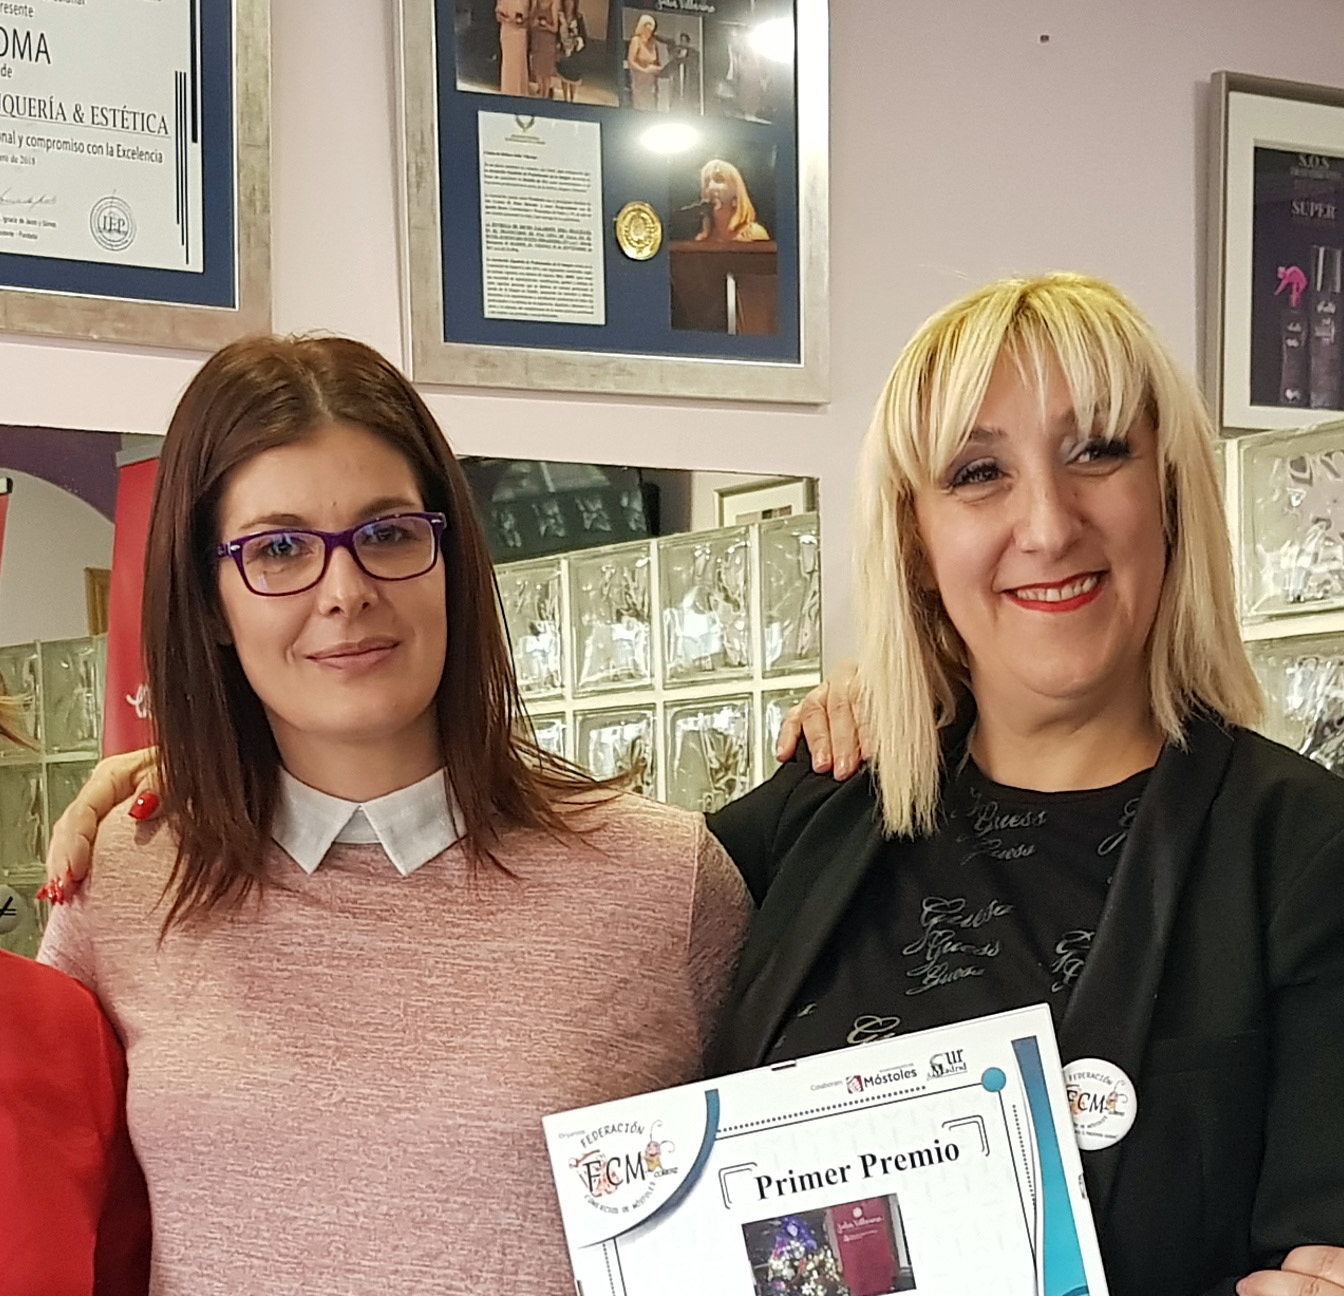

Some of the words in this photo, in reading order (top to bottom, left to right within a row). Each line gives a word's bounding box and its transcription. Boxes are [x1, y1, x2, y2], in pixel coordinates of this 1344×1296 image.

[0, 63, 13, 79] de
[72, 101, 85, 124] &
[90, 104, 169, 136] ESTÉTICA
[17, 134, 23, 149] y
[26, 133, 85, 155] compromiso
[86, 143, 104, 157] con
[105, 143, 115, 158] la
[116, 144, 163, 164] Excelencia
[864, 1068, 918, 1088] Móstoles
[580, 1121, 645, 1149] FEDERACIÓN
[756, 1164, 852, 1200] Primer
[859, 1138, 960, 1179] Premio
